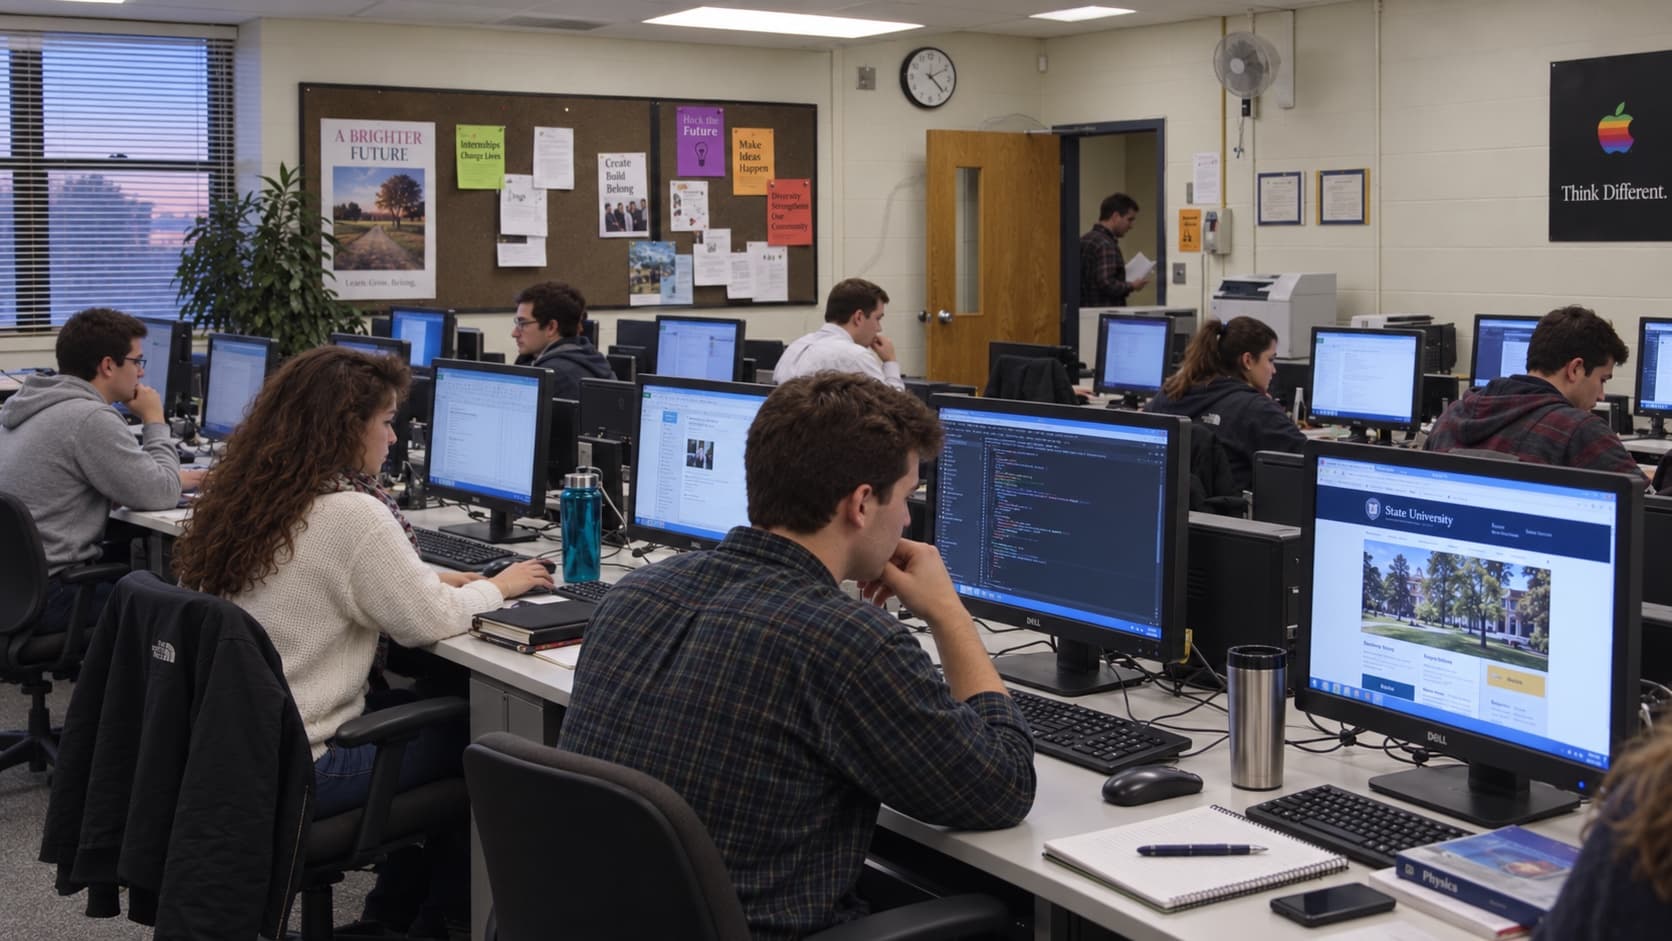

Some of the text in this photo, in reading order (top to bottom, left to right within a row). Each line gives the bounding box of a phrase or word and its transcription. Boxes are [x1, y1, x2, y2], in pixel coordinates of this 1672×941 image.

[683, 126, 718, 136] Future
[335, 129, 422, 145] A BRIGHTER
[460, 140, 501, 151] Internships
[739, 140, 762, 150] Make
[351, 146, 409, 161] FUTURE
[739, 152, 761, 161] Ideas
[605, 158, 632, 168] Create
[739, 164, 768, 175] Happen
[606, 172, 626, 181] Build
[606, 184, 634, 195] Belong
[1561, 182, 1668, 201] Think Different.
[1385, 505, 1407, 518] State
[1409, 509, 1454, 528] University
[1026, 616, 1041, 627] DELL
[1427, 731, 1447, 746] DELL
[1422, 870, 1459, 893] Physics
